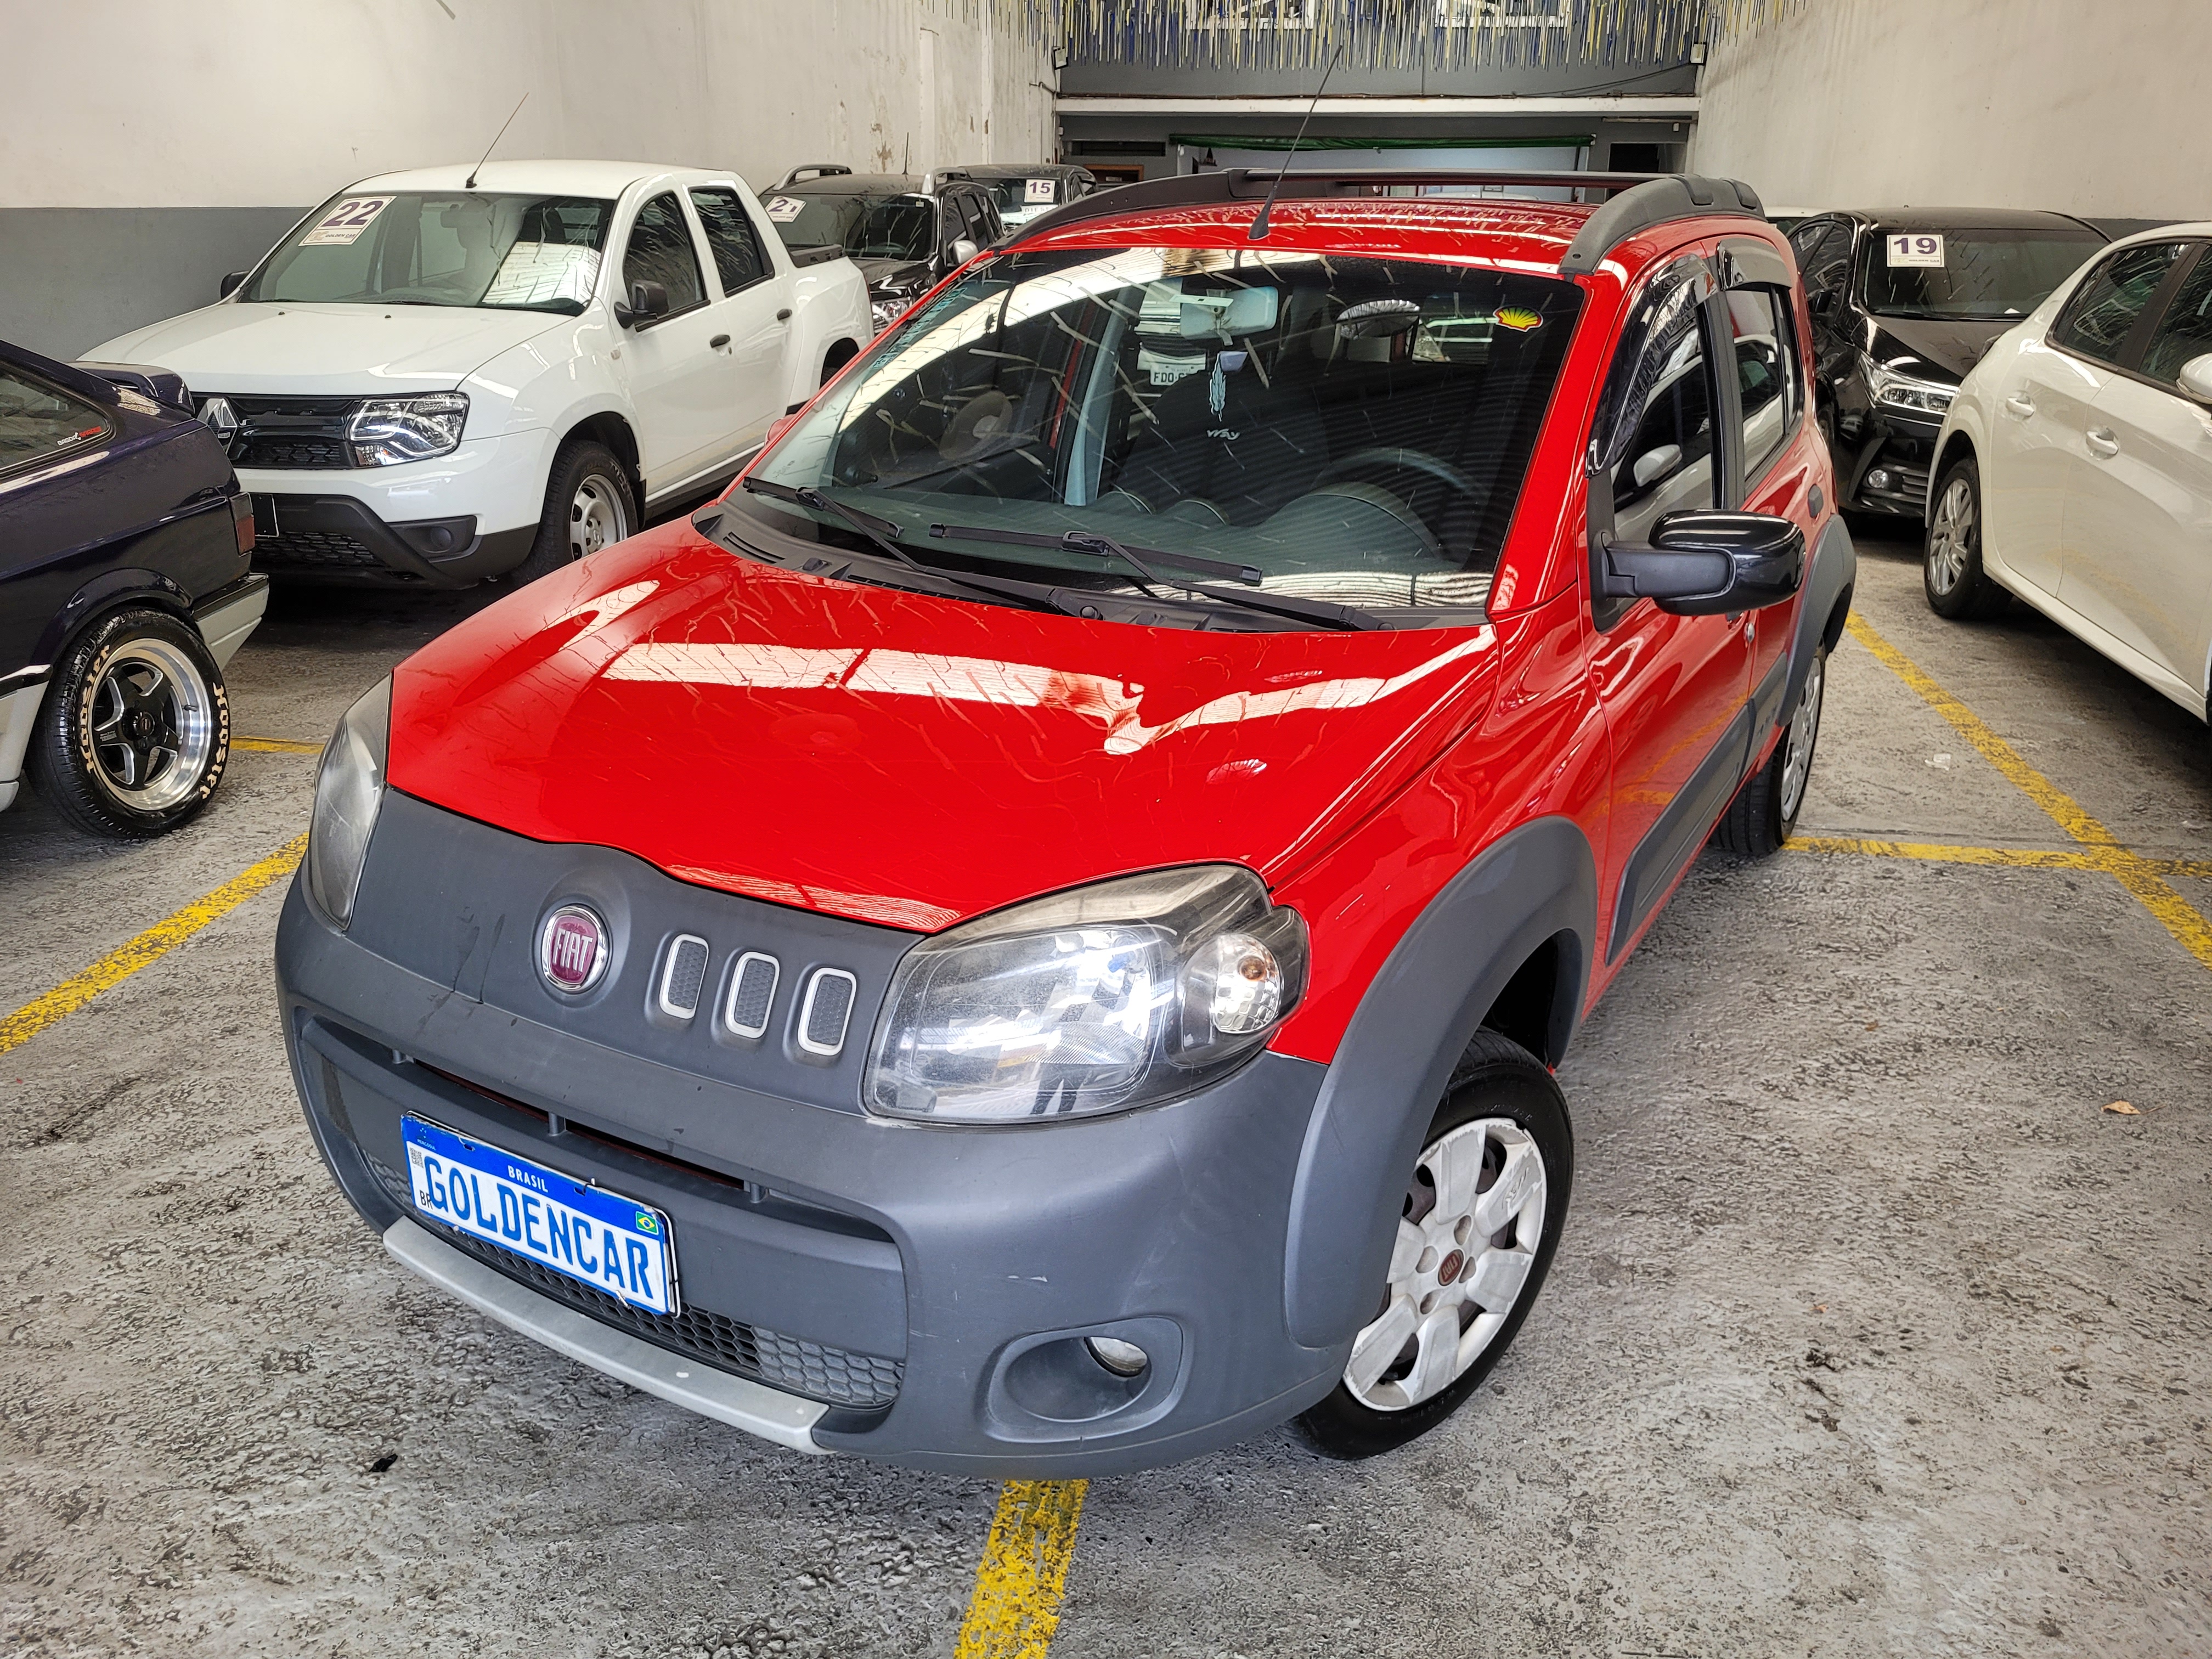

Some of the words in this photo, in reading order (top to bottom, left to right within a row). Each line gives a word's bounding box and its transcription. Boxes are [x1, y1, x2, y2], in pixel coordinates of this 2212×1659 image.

[1029, 182, 1051, 194] 15
[320, 200, 384, 227] 22
[1894, 238, 1937, 254] 19
[552, 928, 593, 972] FIAT
[507, 1165, 549, 1193] BRASIL
[419, 1189, 433, 1210] BR
[424, 1155, 654, 1300] GOLDENCAR
[1442, 1255, 1458, 1280] FIAT
